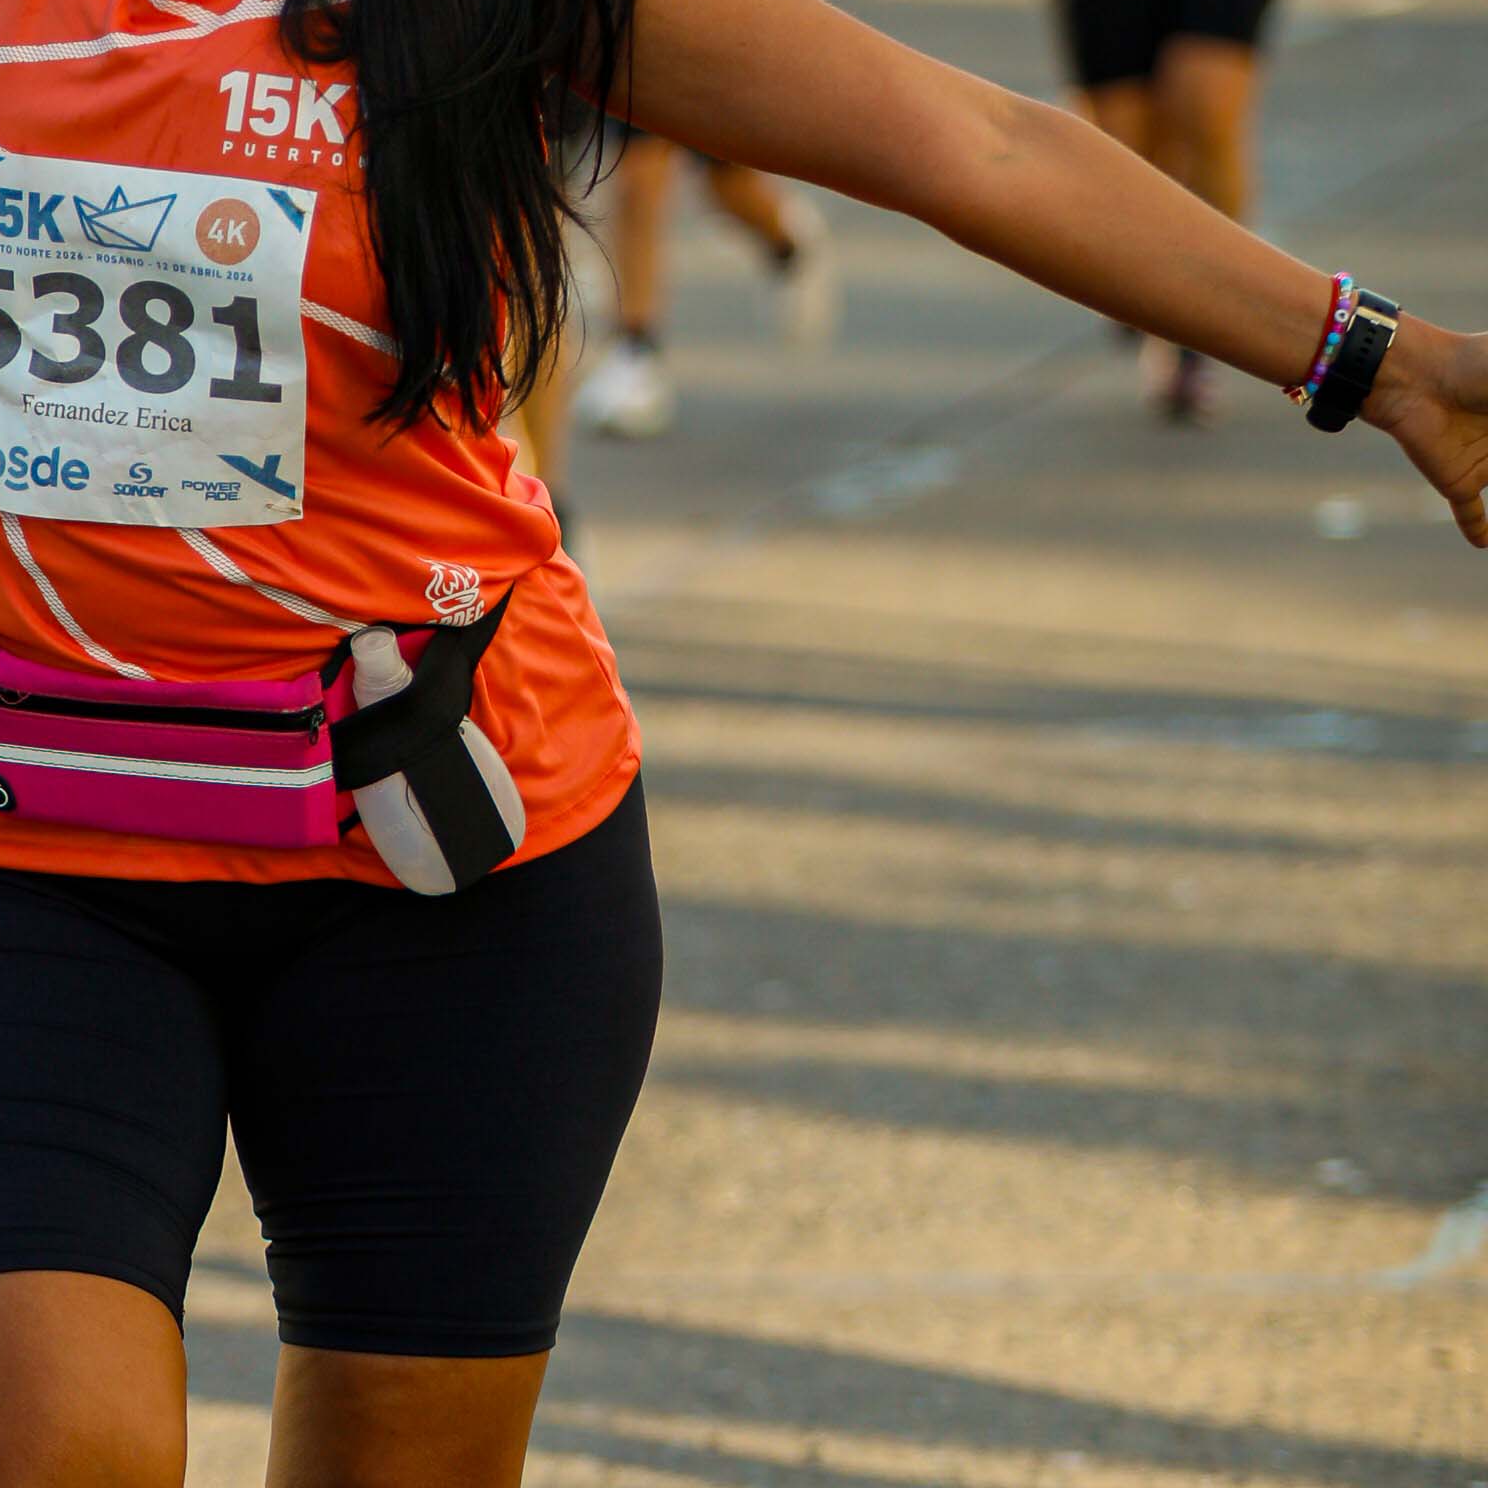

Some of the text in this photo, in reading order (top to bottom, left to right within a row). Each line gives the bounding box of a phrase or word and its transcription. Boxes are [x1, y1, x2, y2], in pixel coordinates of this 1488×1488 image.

[219, 70, 351, 144] 15K
[222, 140, 343, 166] PUERTO
[208, 217, 248, 246] 4K
[16, 247, 51, 259] NORTE
[56, 250, 84, 261] 2026
[96, 254, 144, 267] ROSARIO
[157, 261, 169, 272] 12
[173, 263, 186, 274] DE
[190, 266, 223, 279] ABRIL
[226, 271, 254, 283] 2026
[22, 394, 193, 433] Fernandez Erica
[181, 480, 241, 492] POWER
